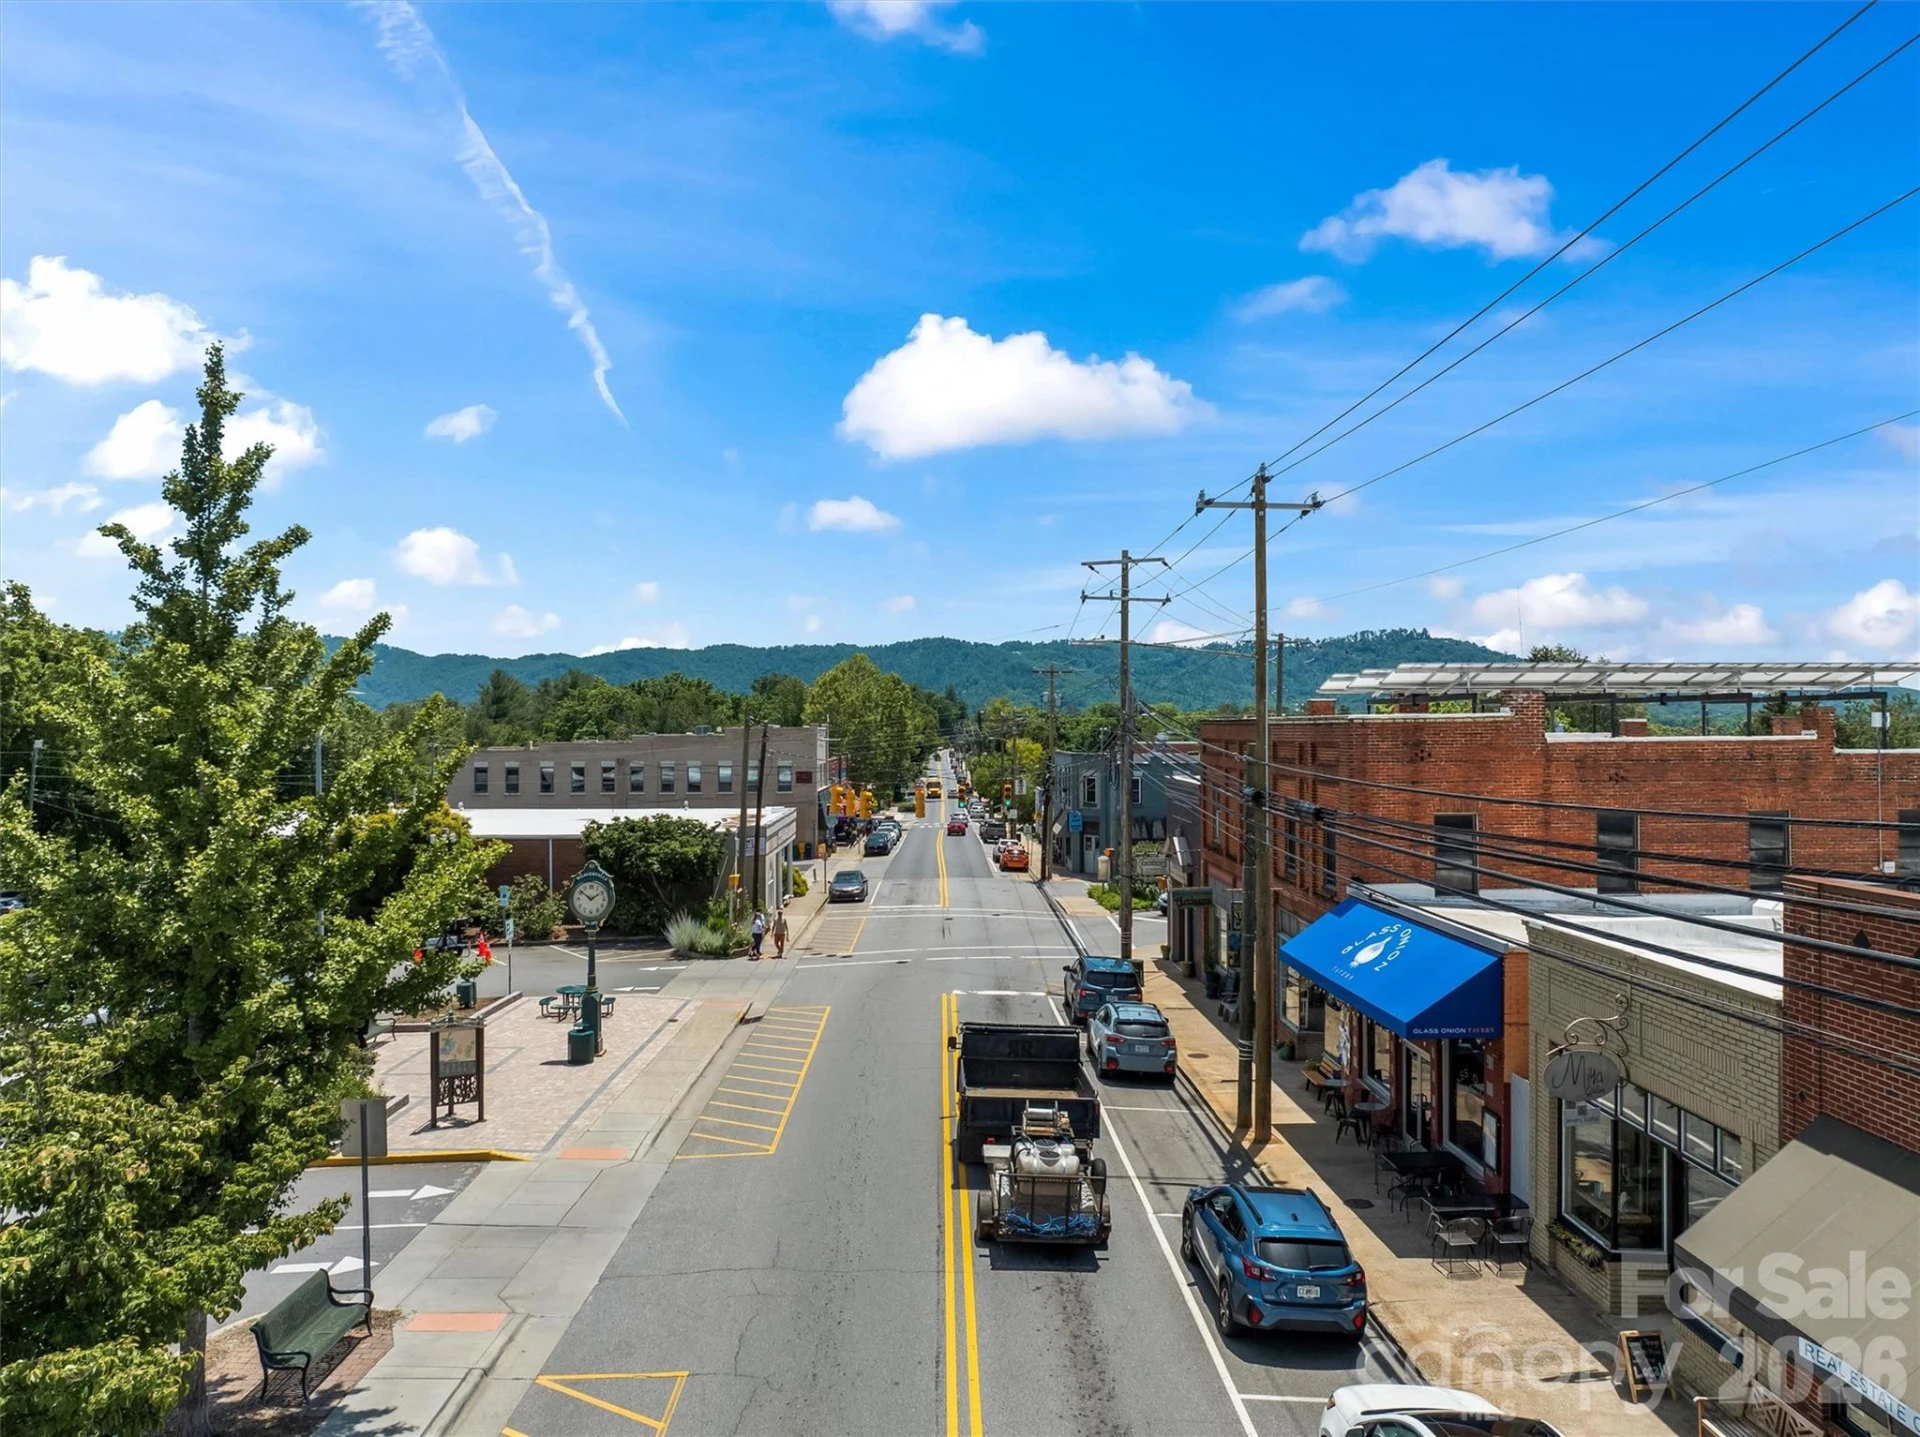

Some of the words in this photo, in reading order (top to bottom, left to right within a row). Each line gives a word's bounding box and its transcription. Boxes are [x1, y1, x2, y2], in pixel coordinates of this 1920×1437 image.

[1341, 924, 1402, 955] GLASS
[1374, 928, 1412, 972] ONION
[1413, 1027, 1439, 1035] GLASS
[1551, 1054, 1604, 1090] Miya
[1804, 1342, 1846, 1378] REAL
[1850, 1371, 1906, 1422] ESTATE
